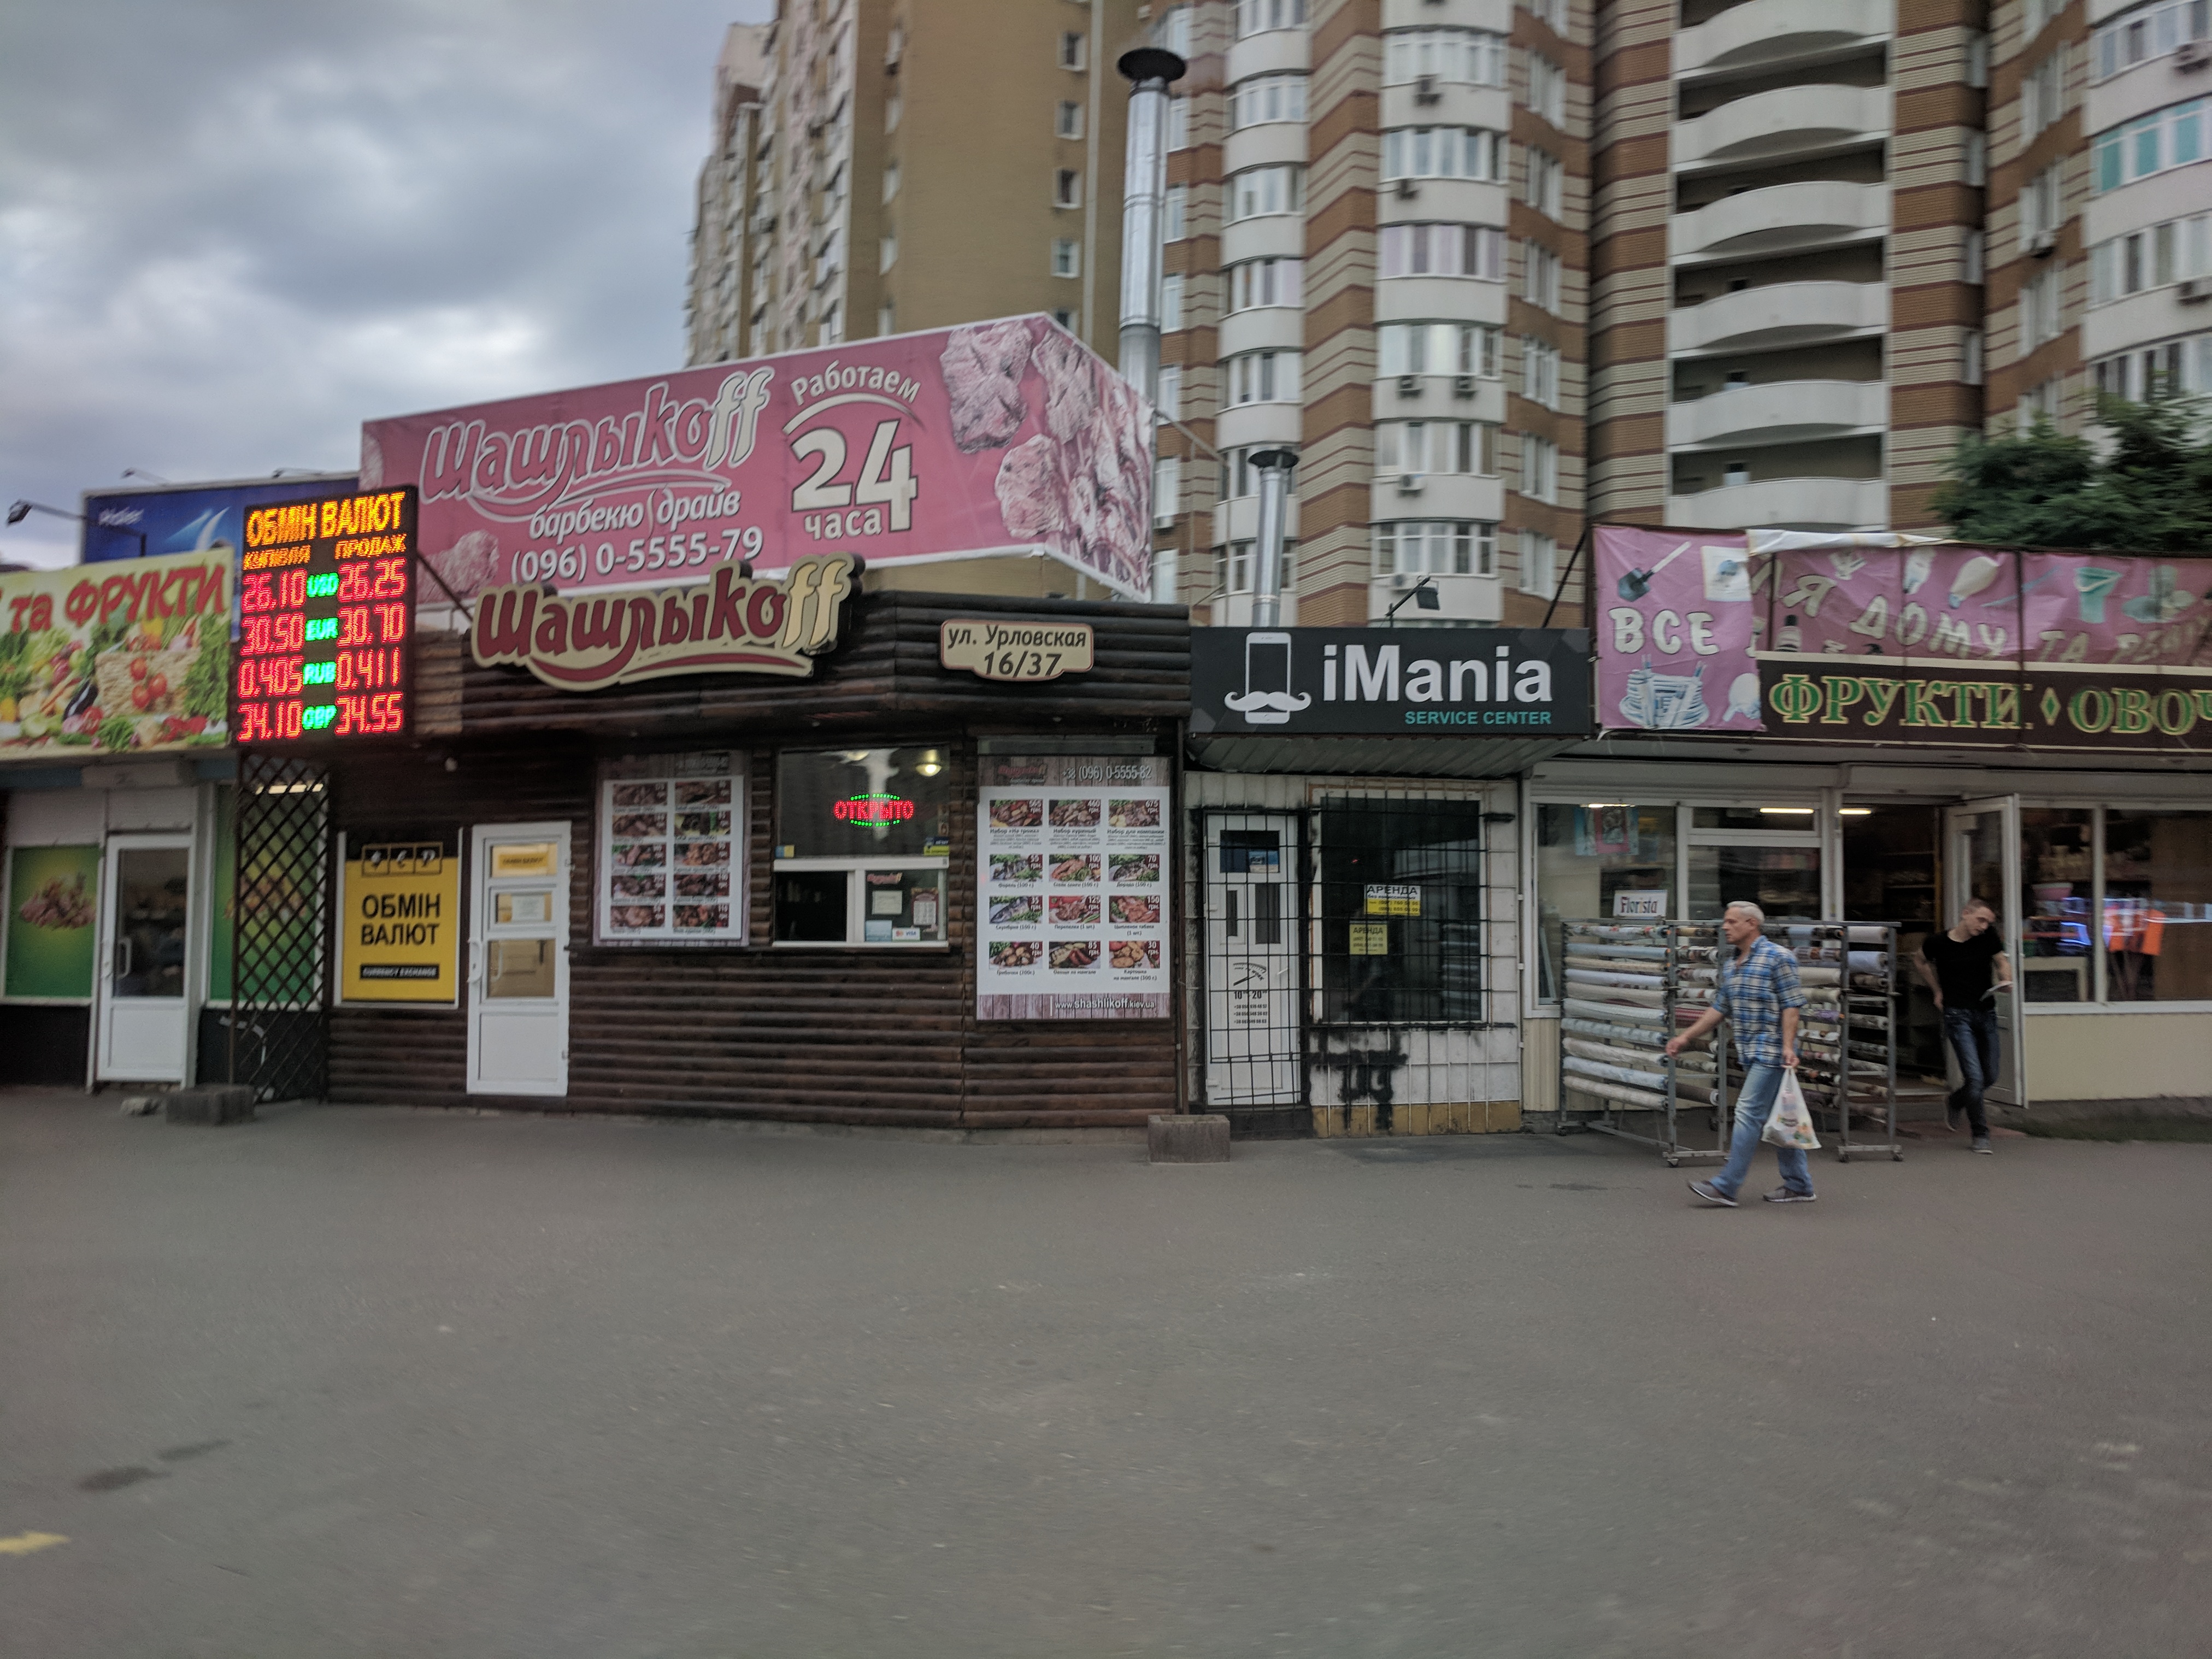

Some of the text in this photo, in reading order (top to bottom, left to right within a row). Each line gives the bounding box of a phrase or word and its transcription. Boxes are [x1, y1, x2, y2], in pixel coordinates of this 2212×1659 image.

[790, 359, 921, 407] Работаем
[790, 419, 918, 533] 24
[246, 491, 406, 548] ОБМІН ВАЛЮТ
[529, 483, 741, 545] барбекю драйв
[804, 507, 883, 540] часа
[334, 533, 407, 560] ПРОДАЖ
[510, 526, 763, 584] (096) 0-5555-79
[8, 564, 226, 634] та ФРУКТИ
[241, 557, 407, 613] 26.10 USD 26.25
[240, 602, 406, 656] 30.50 EUR 30.70
[948, 624, 1086, 650] ул. Урловская
[1608, 606, 1720, 656] ВСЕ
[1848, 594, 2009, 656] ДОМУ
[238, 646, 401, 699] 0.405 RUB 0.411
[984, 650, 1062, 678] 16/37
[1322, 644, 1553, 703] iMania
[237, 691, 404, 742] 34.10 GBP 34.55
[1404, 711, 1552, 726] SERVICE CENTER
[1768, 673, 2034, 730] ФРУКТИ
[1078, 765, 1103, 782] (096)
[1105, 764, 1152, 780] 0-5555-82
[833, 799, 915, 820] ОТКРЫТО
[362, 893, 440, 919] ОБМІН
[1366, 886, 1417, 896] АРЕНДА
[1620, 896, 1658, 914] Florista
[361, 922, 440, 946] ВАЛЮТ
